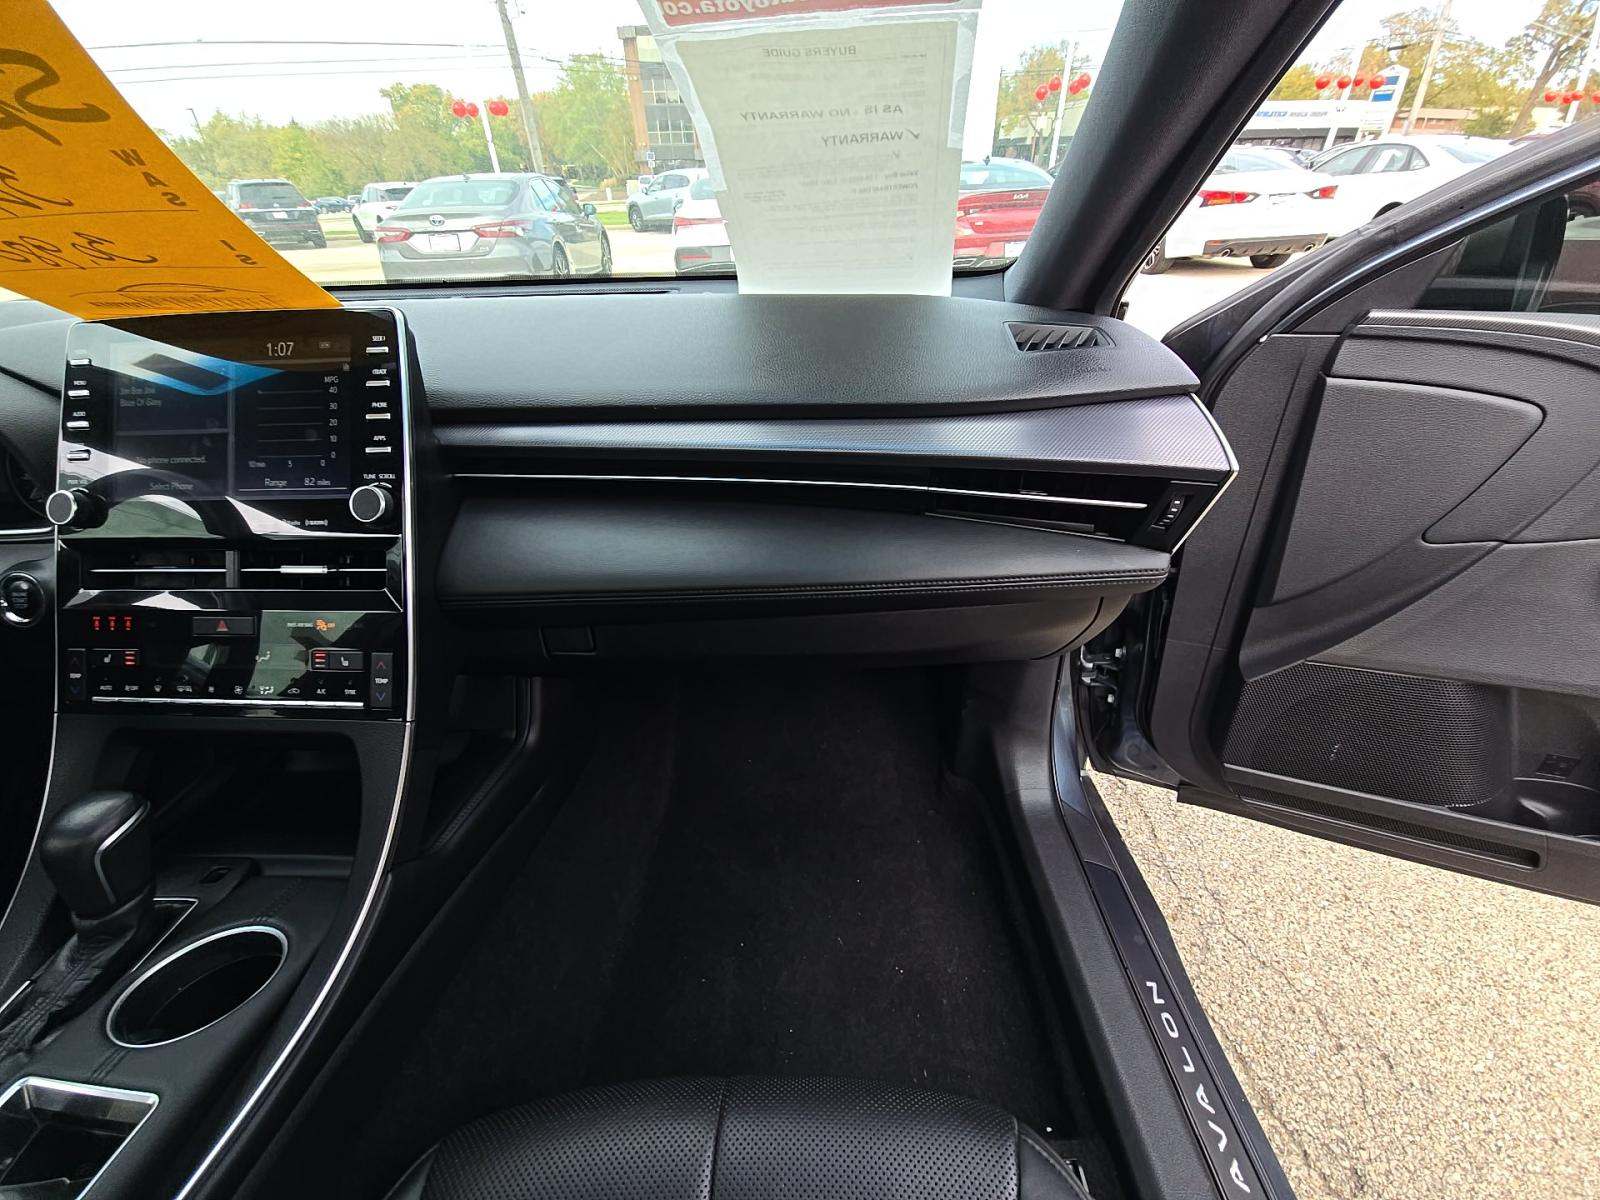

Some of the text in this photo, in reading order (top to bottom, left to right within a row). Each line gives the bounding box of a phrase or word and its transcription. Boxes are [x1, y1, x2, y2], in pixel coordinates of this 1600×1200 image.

[266, 341, 295, 357] 1:07
[324, 375, 339, 383] MPG
[328, 386, 338, 394] 40
[328, 402, 338, 410] 30
[328, 418, 338, 426] 20
[264, 478, 288, 488] Range
[303, 477, 316, 486] 82
[1146, 981, 1251, 1194] AVALON
